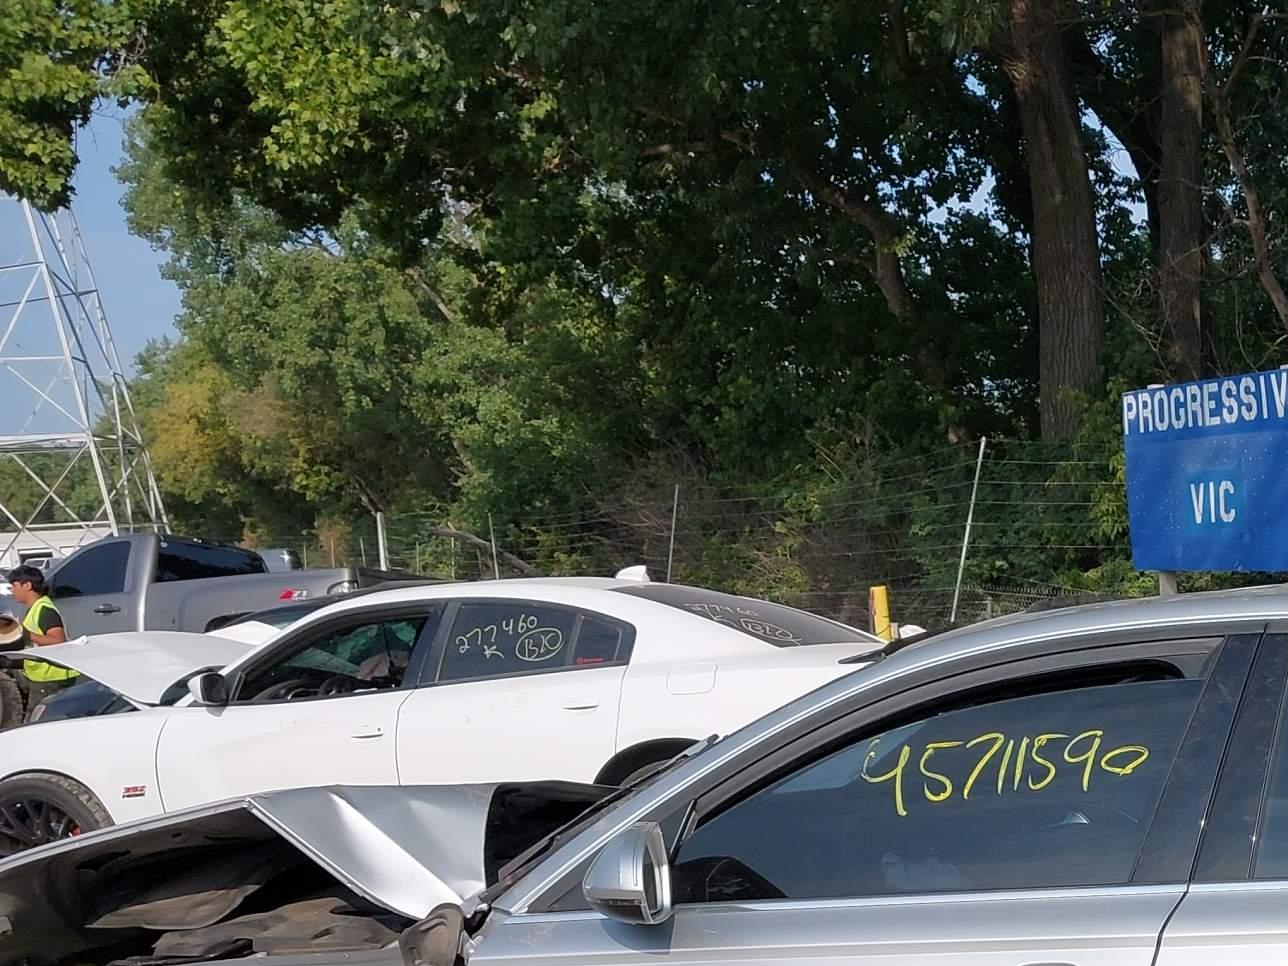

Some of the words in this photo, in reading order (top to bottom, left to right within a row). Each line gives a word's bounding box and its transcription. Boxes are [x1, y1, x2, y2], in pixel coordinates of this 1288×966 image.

[1190, 480, 1236, 524] VIC
[456, 614, 538, 653] 277460
[861, 730, 1149, 816] 45711590
